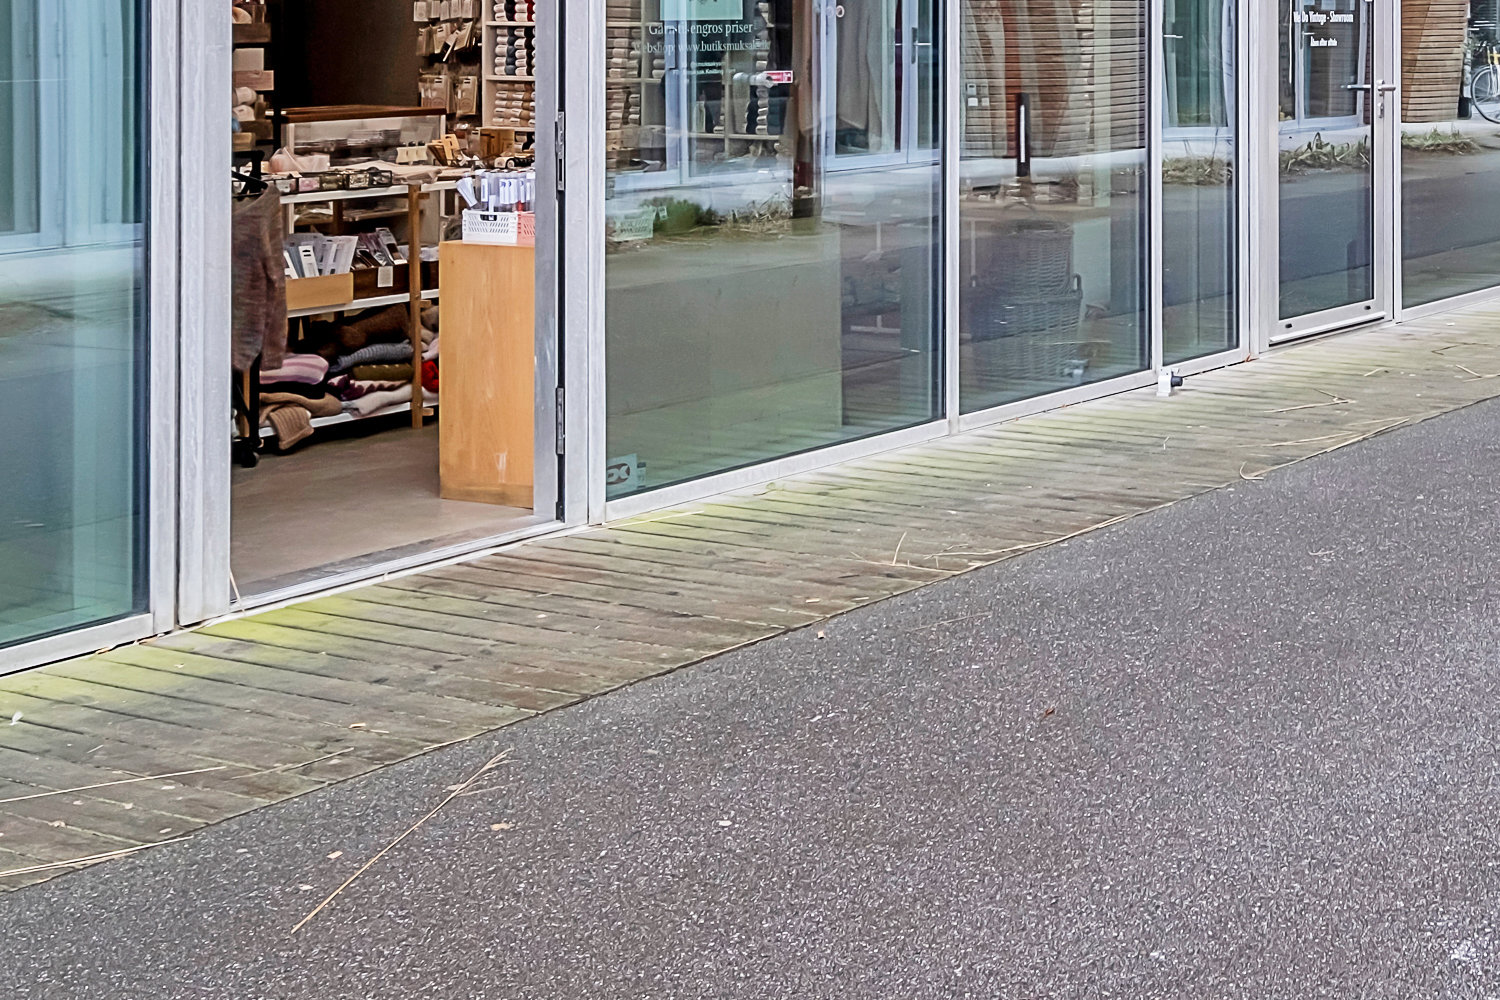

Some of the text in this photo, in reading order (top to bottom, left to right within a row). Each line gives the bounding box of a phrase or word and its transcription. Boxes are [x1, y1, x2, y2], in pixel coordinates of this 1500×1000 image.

[1330, 11, 1354, 23] Showroom
[691, 22, 723, 37] engros
[725, 21, 753, 37] priser
